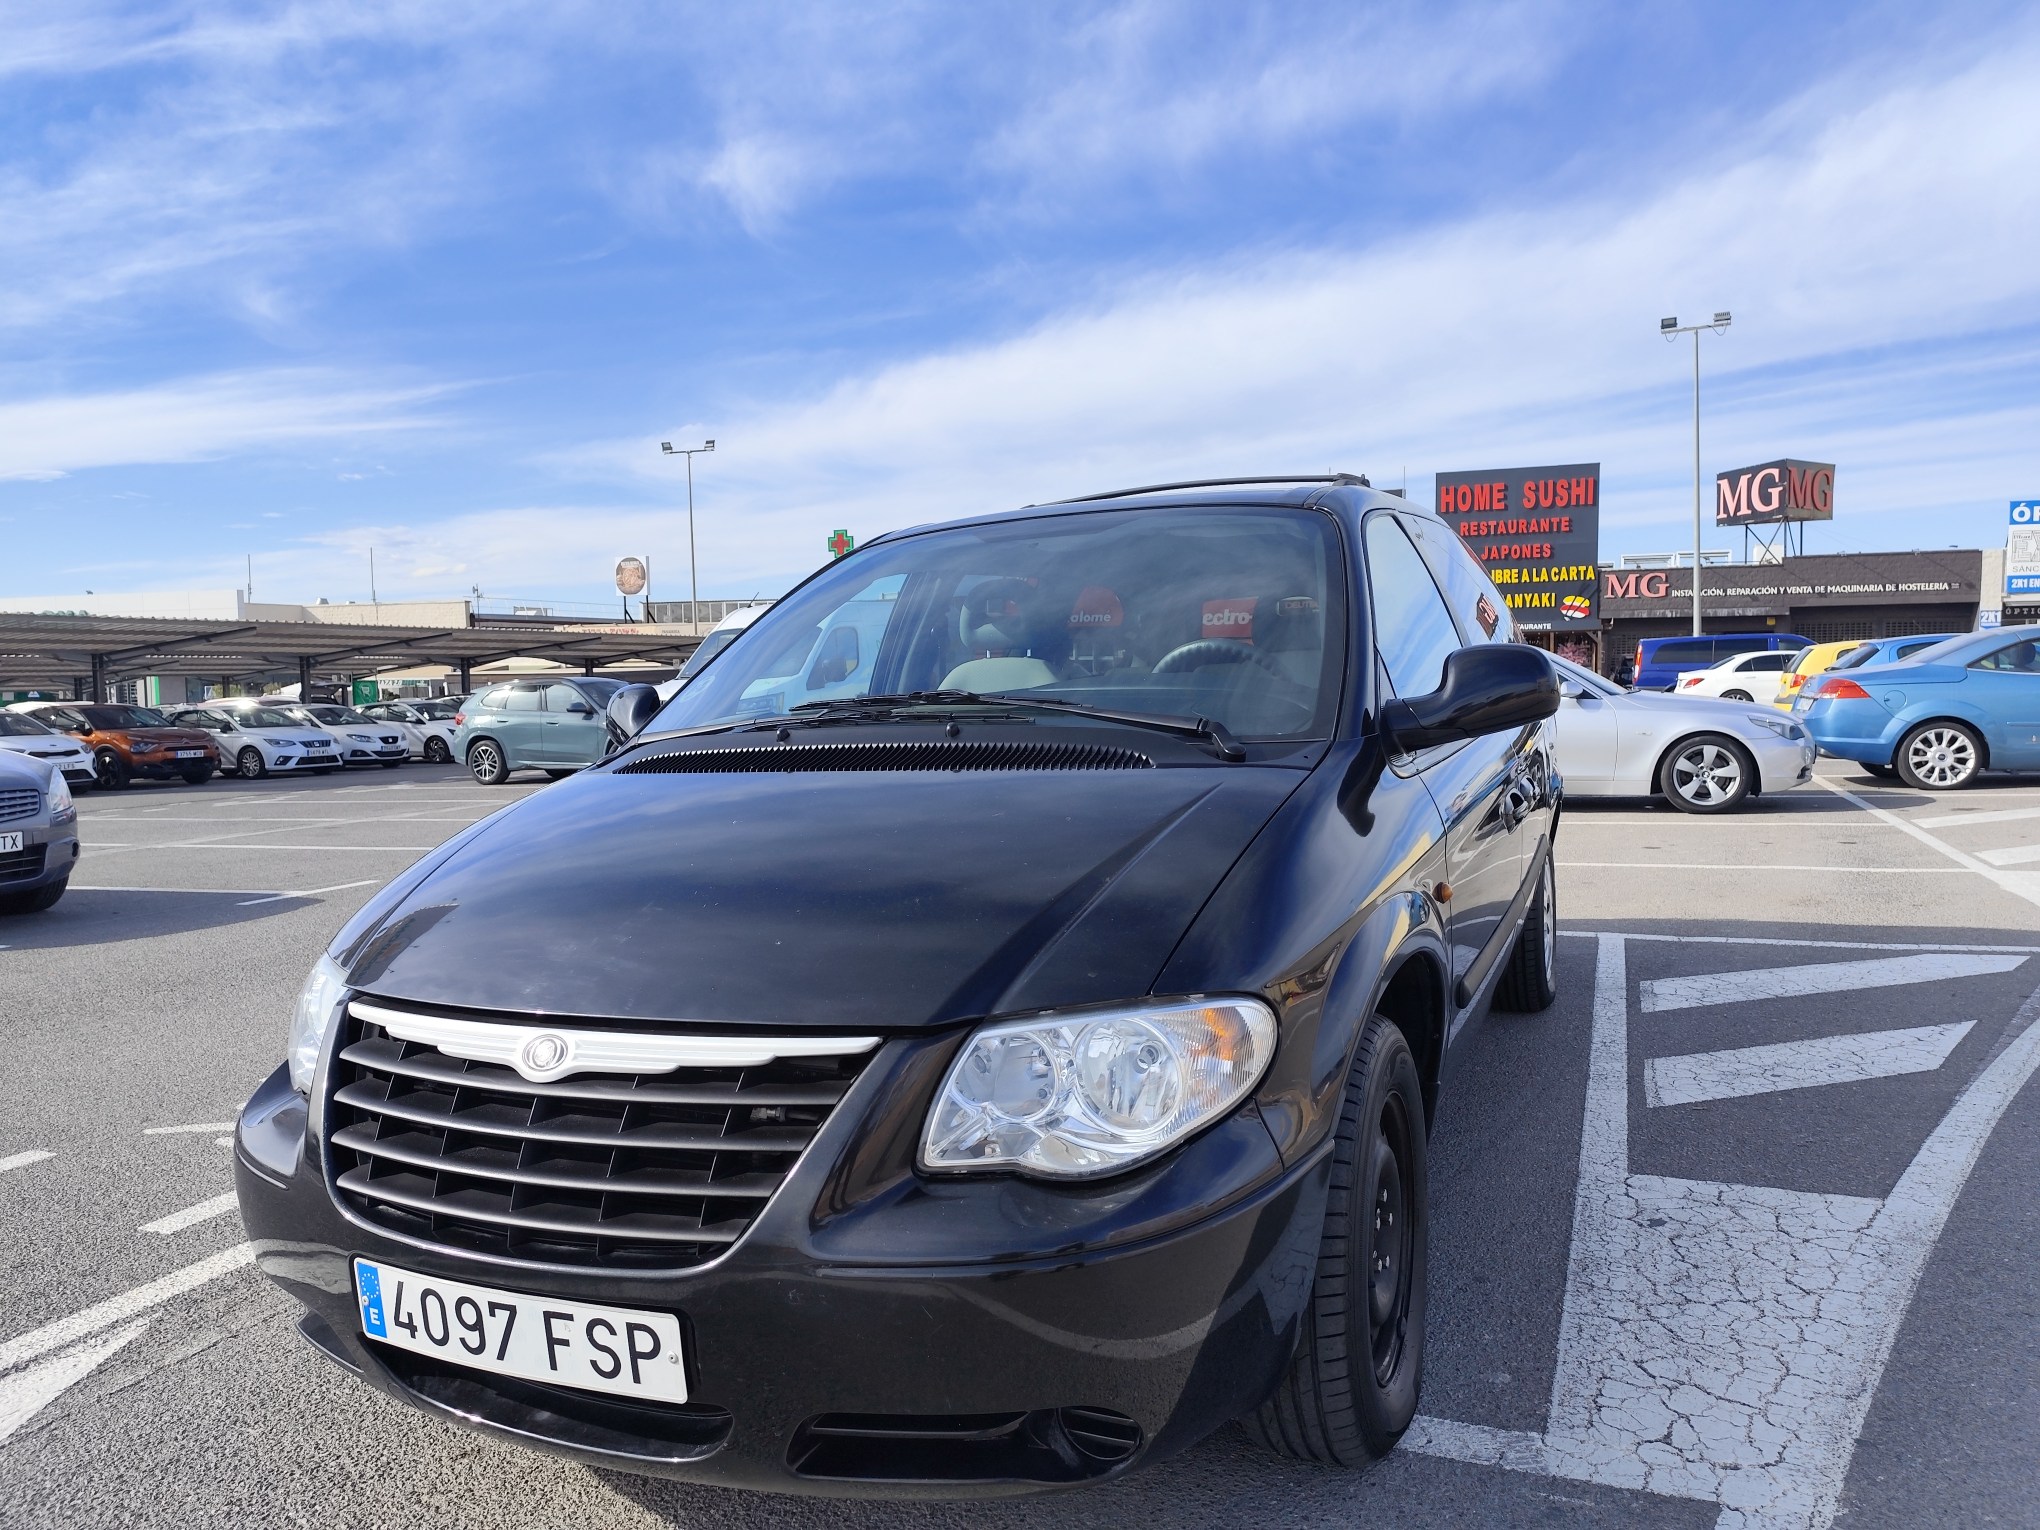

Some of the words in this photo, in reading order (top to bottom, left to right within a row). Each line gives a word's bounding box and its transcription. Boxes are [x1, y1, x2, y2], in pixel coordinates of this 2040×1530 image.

[1440, 482, 1506, 513] HOME
[1522, 476, 1595, 509] SUSHI
[1717, 468, 1783, 519] MG
[1786, 466, 1832, 512] MG
[1460, 516, 1570, 537] RESTAURANTE
[1480, 543, 1552, 561] JAPONES
[1491, 568, 1519, 584] IBRE
[1521, 568, 1530, 583] A
[1532, 567, 1549, 583] LA
[1551, 565, 1596, 582] CARTA
[2011, 578, 2028, 588] 2X1
[1604, 572, 1670, 599] MG
[1671, 586, 1726, 598] INSTACIÓN,
[1727, 585, 1778, 596] REPARACIÓN
[1779, 586, 1785, 595] Y
[1786, 585, 1813, 594] VENTA
[1814, 585, 1826, 593] DE
[1827, 583, 1884, 593] MAQUINARIA
[1885, 583, 1897, 592] DE
[1505, 592, 1556, 609] ANYAKI
[1067, 609, 1112, 624] alomé
[0, 834, 19, 850] TX
[369, 1308, 381, 1326] E
[393, 1281, 517, 1361] 4097
[543, 1310, 661, 1384] FSP
